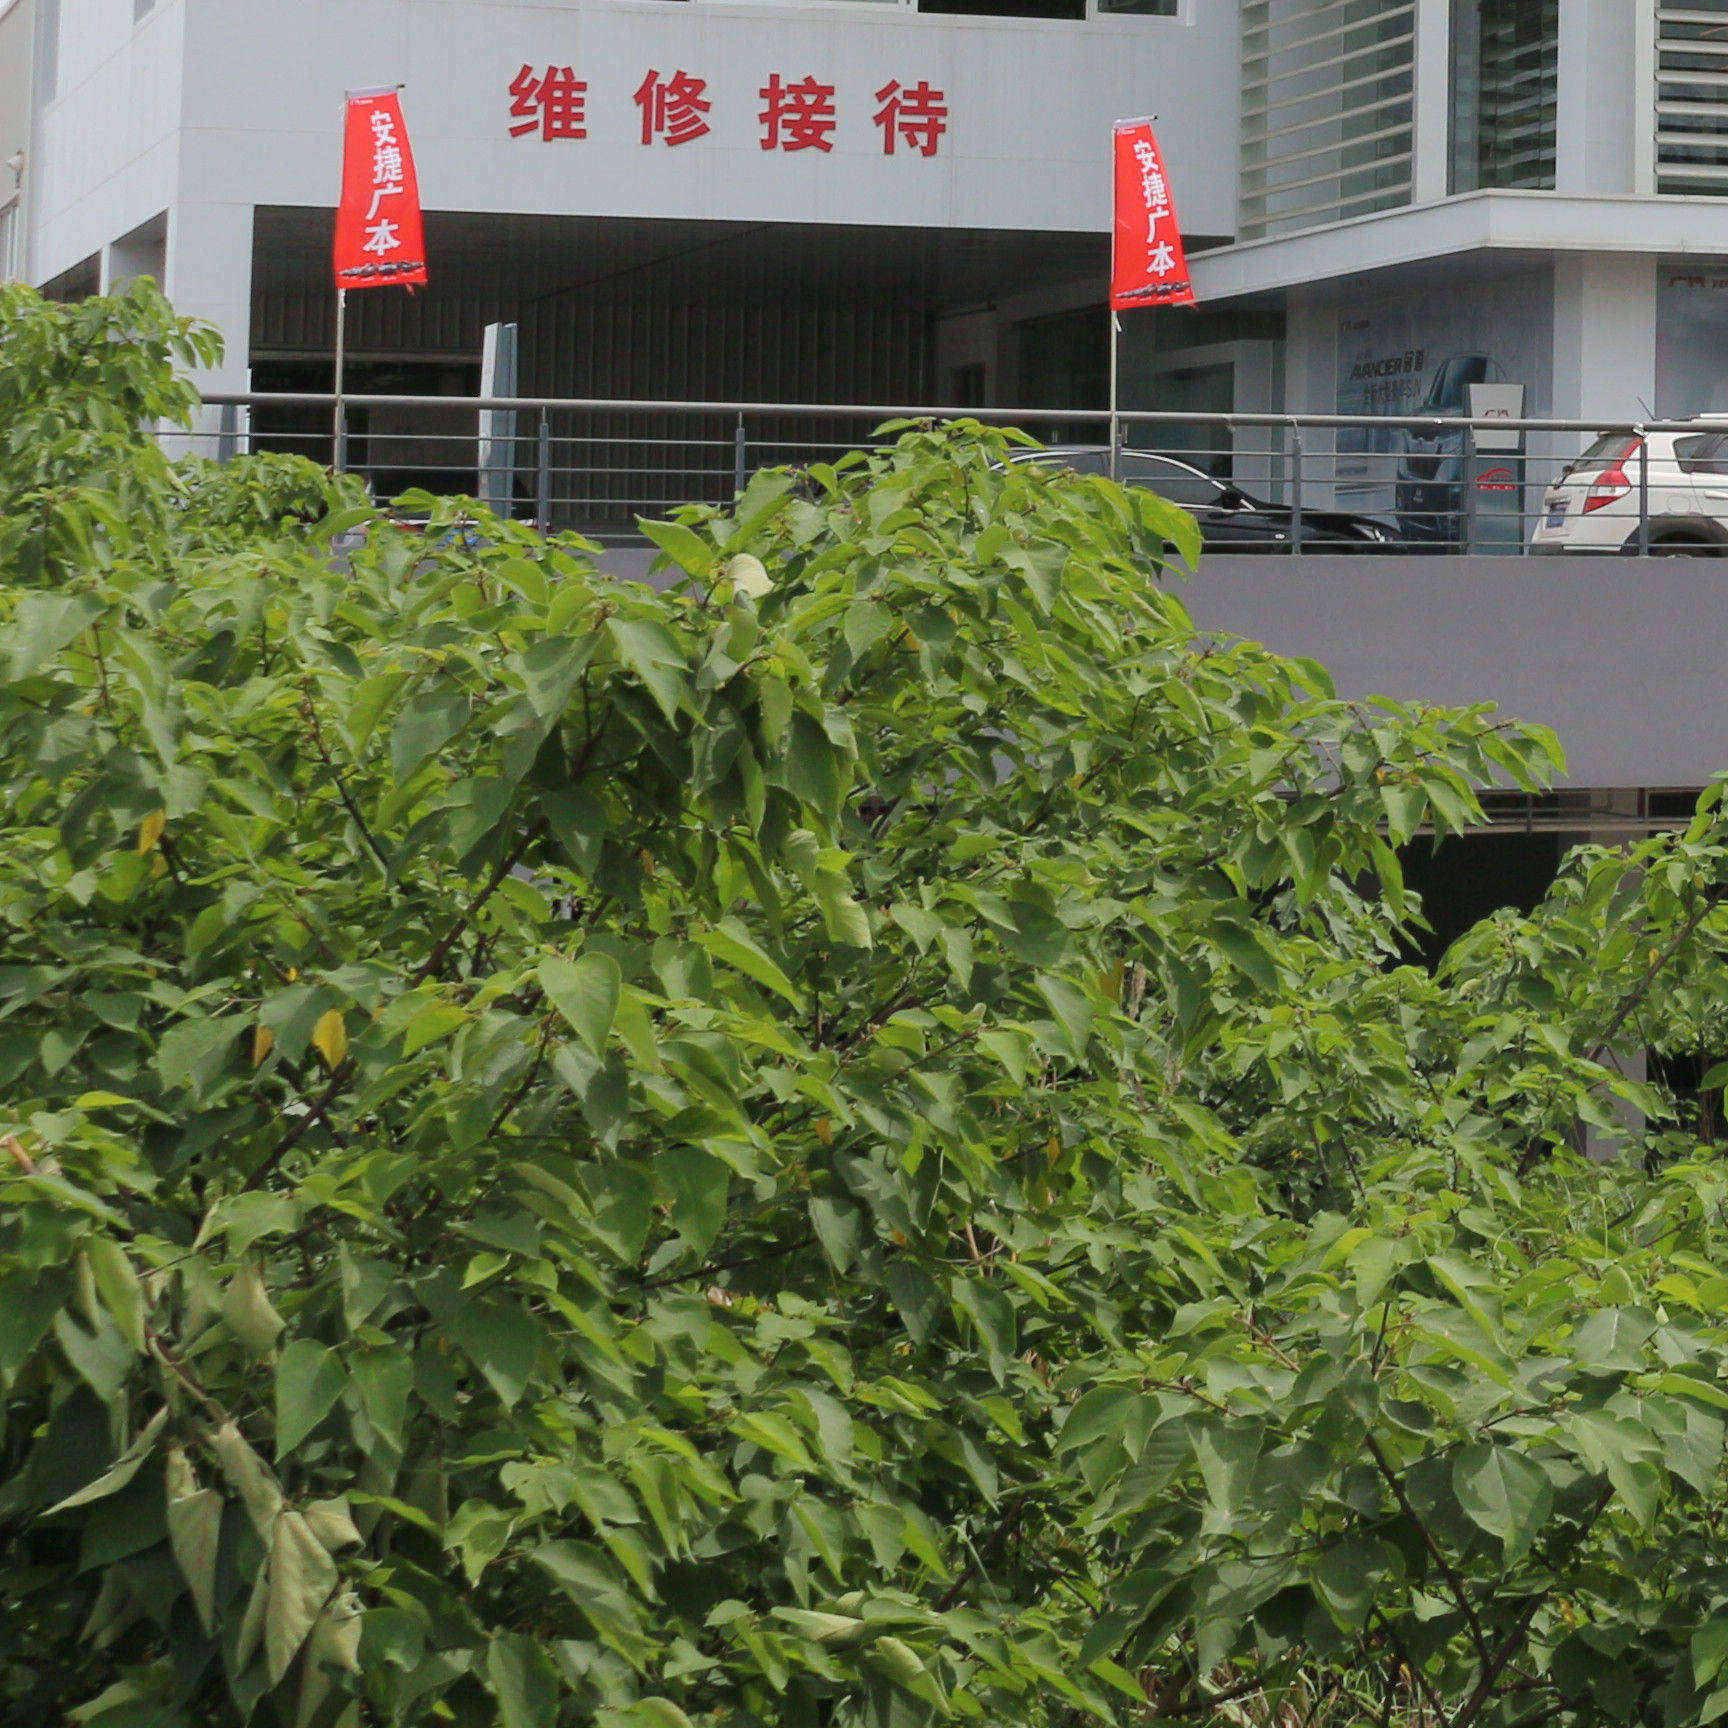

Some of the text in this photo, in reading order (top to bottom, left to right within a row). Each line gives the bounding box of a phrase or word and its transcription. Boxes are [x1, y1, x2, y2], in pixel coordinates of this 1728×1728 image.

[508, 64, 949, 157] 维修接待
[362, 110, 404, 257] 安捷广本
[1133, 139, 1176, 277] 安捷广本
